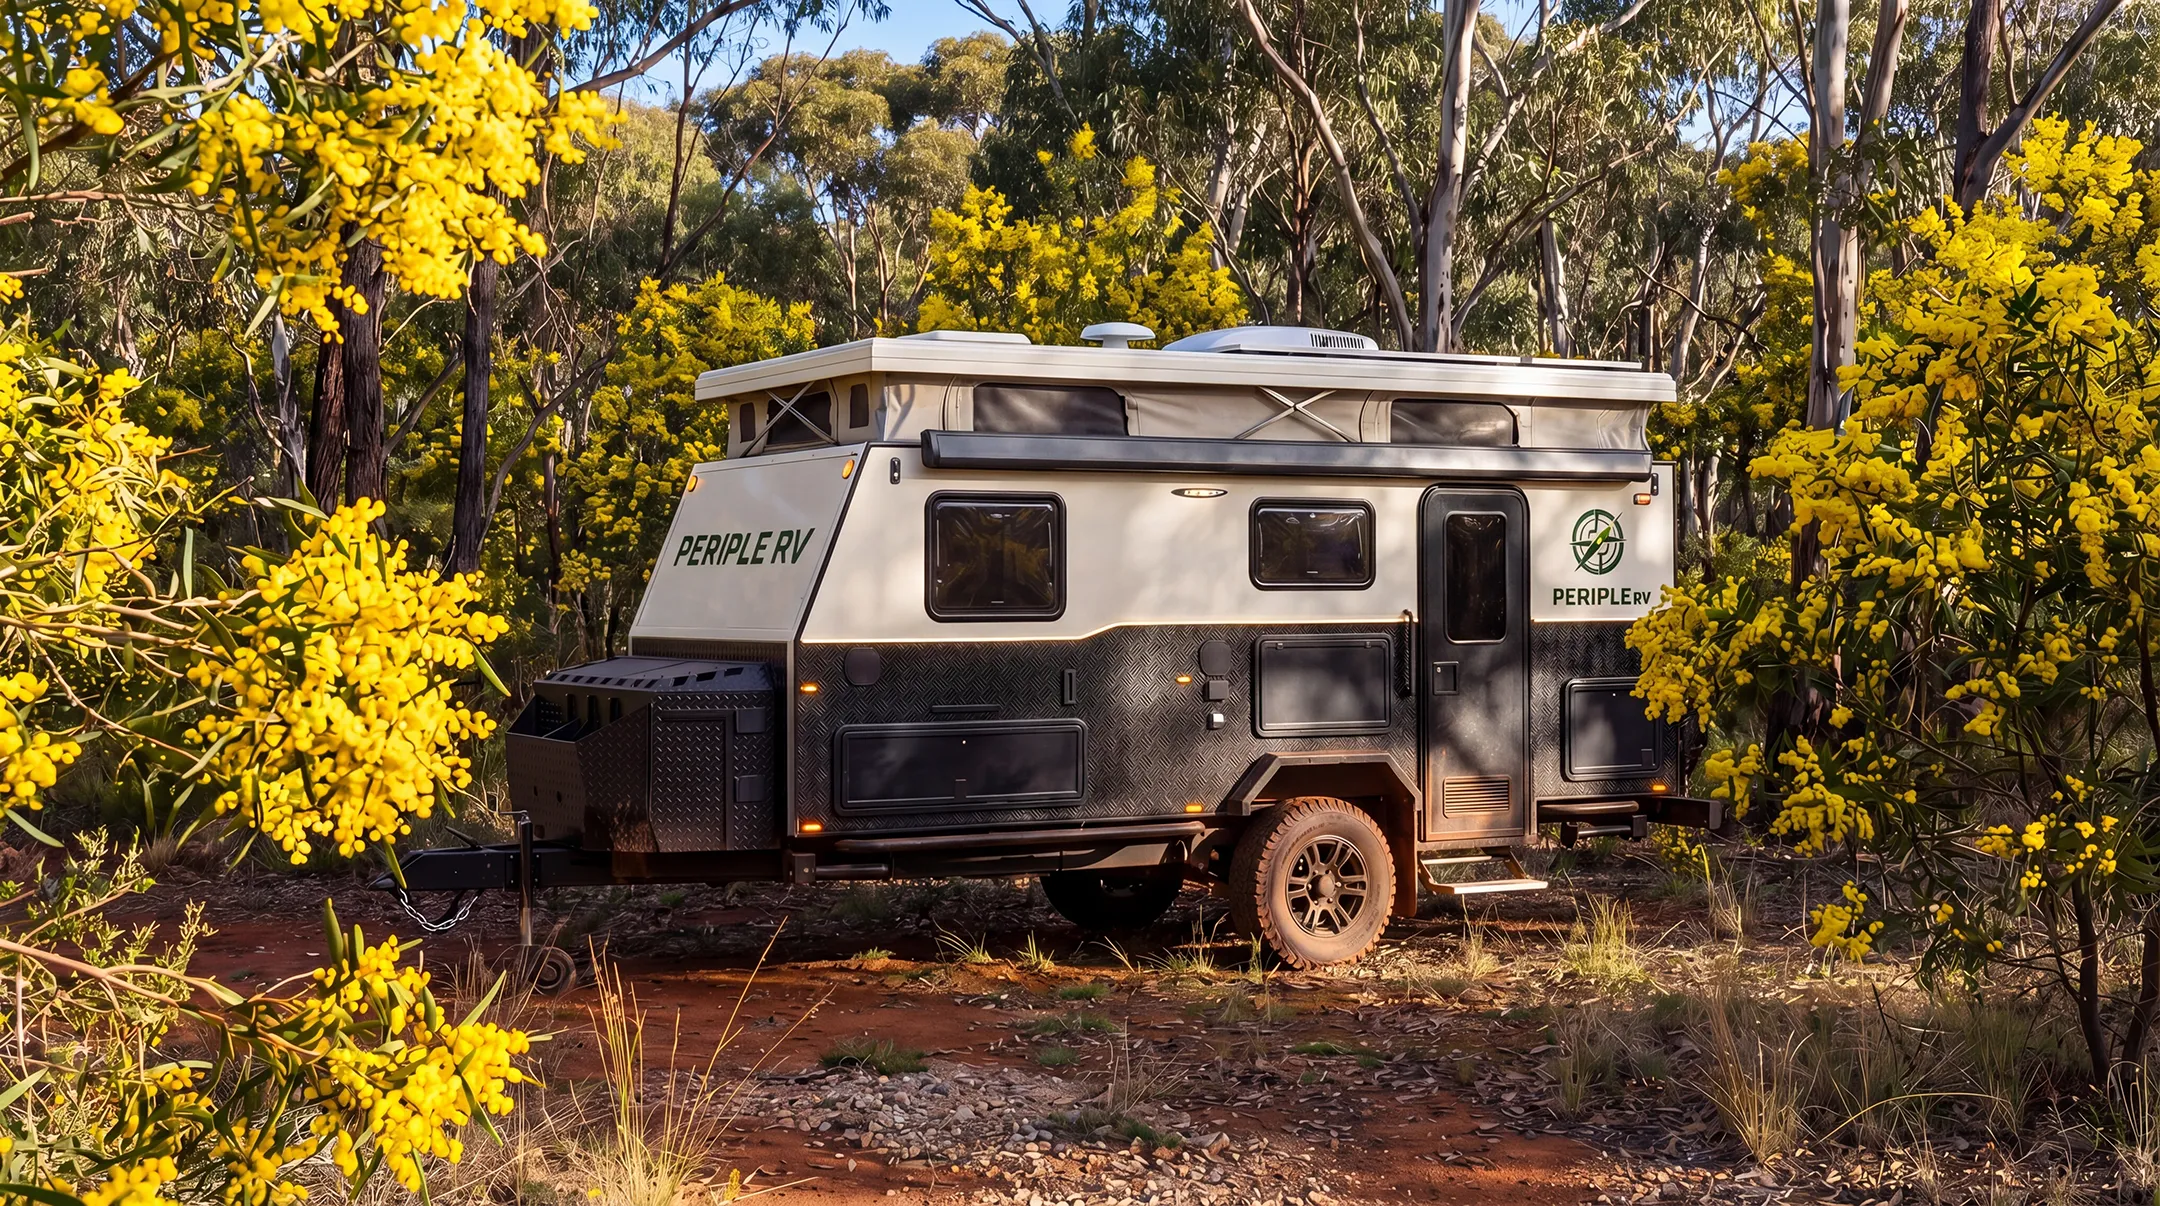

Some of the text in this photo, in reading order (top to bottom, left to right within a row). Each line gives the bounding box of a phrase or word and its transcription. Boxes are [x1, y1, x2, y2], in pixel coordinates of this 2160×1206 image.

[673, 527, 816, 566] PERIPLE RV
[1553, 588, 1632, 606] PERIPLE
